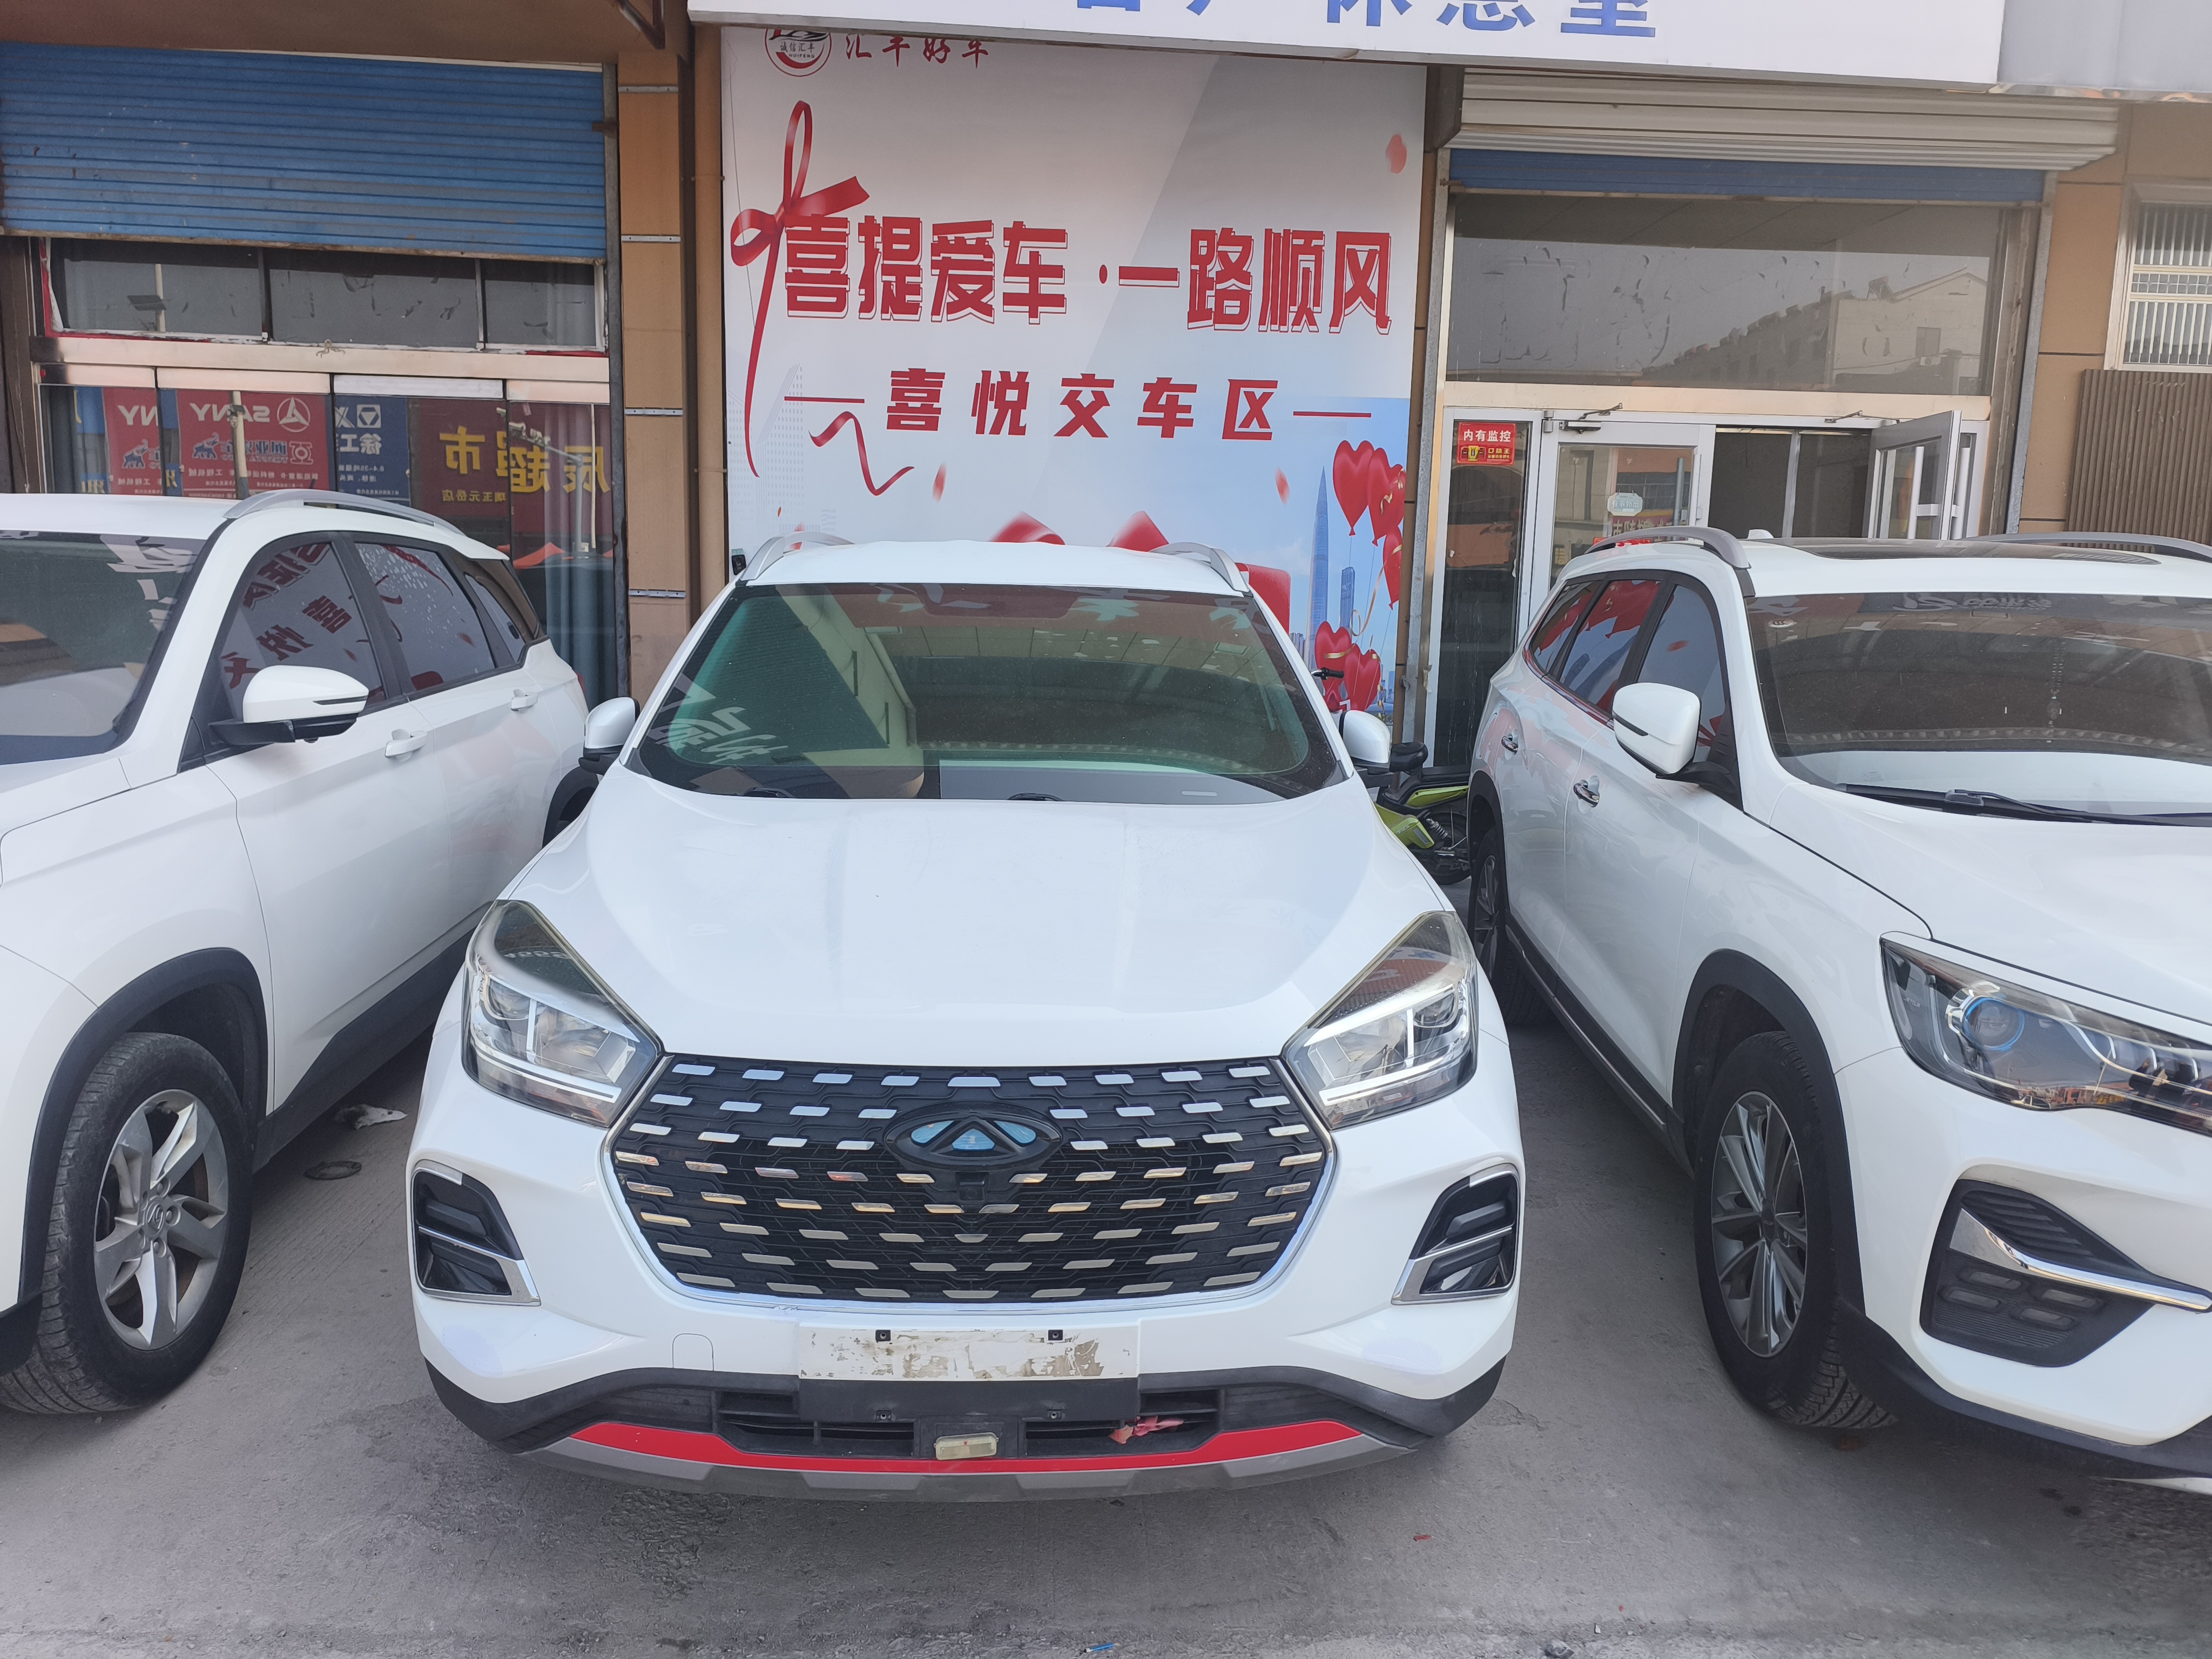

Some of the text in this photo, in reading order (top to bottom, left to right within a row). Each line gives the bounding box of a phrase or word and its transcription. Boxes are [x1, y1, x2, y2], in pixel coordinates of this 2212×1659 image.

[887, 368, 1278, 440] 喜悦交车区
[1464, 429, 1511, 442] 内有监控
